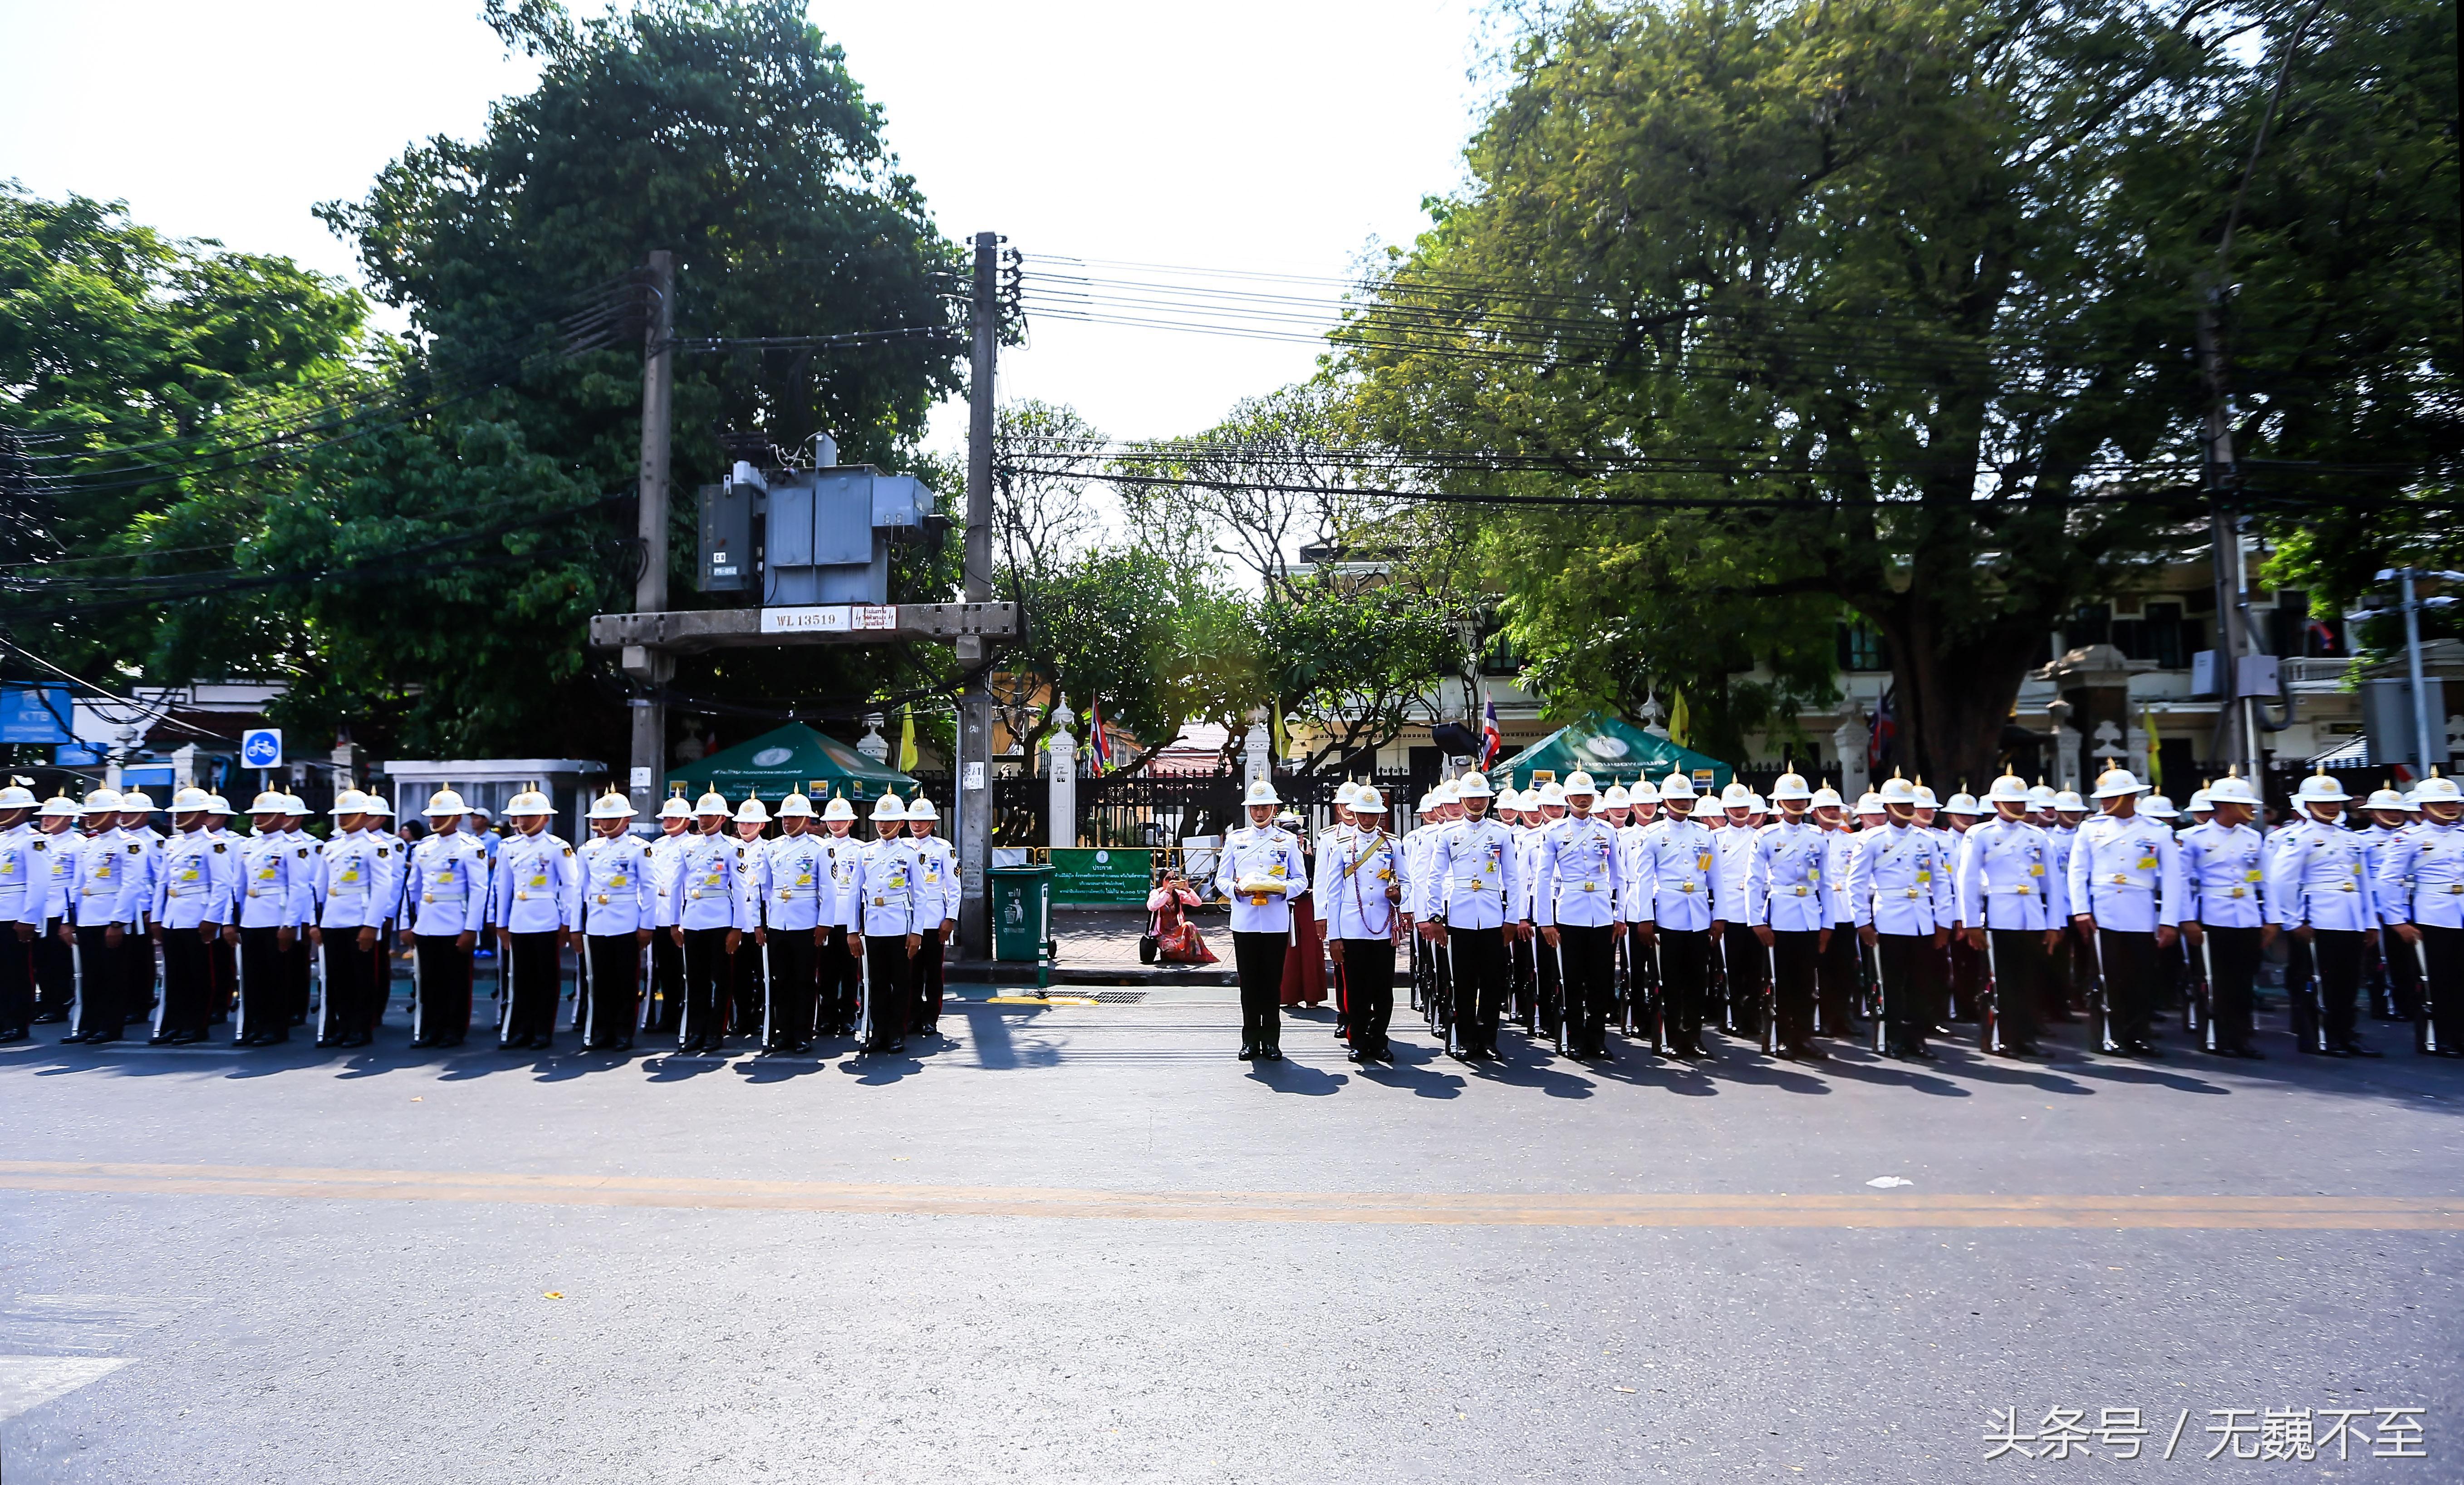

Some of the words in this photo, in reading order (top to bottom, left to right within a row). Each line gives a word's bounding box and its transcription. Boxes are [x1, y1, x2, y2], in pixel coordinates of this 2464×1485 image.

[776, 615, 794, 626] WL
[797, 614, 835, 626] 13519
[19, 711, 50, 721] KTB
